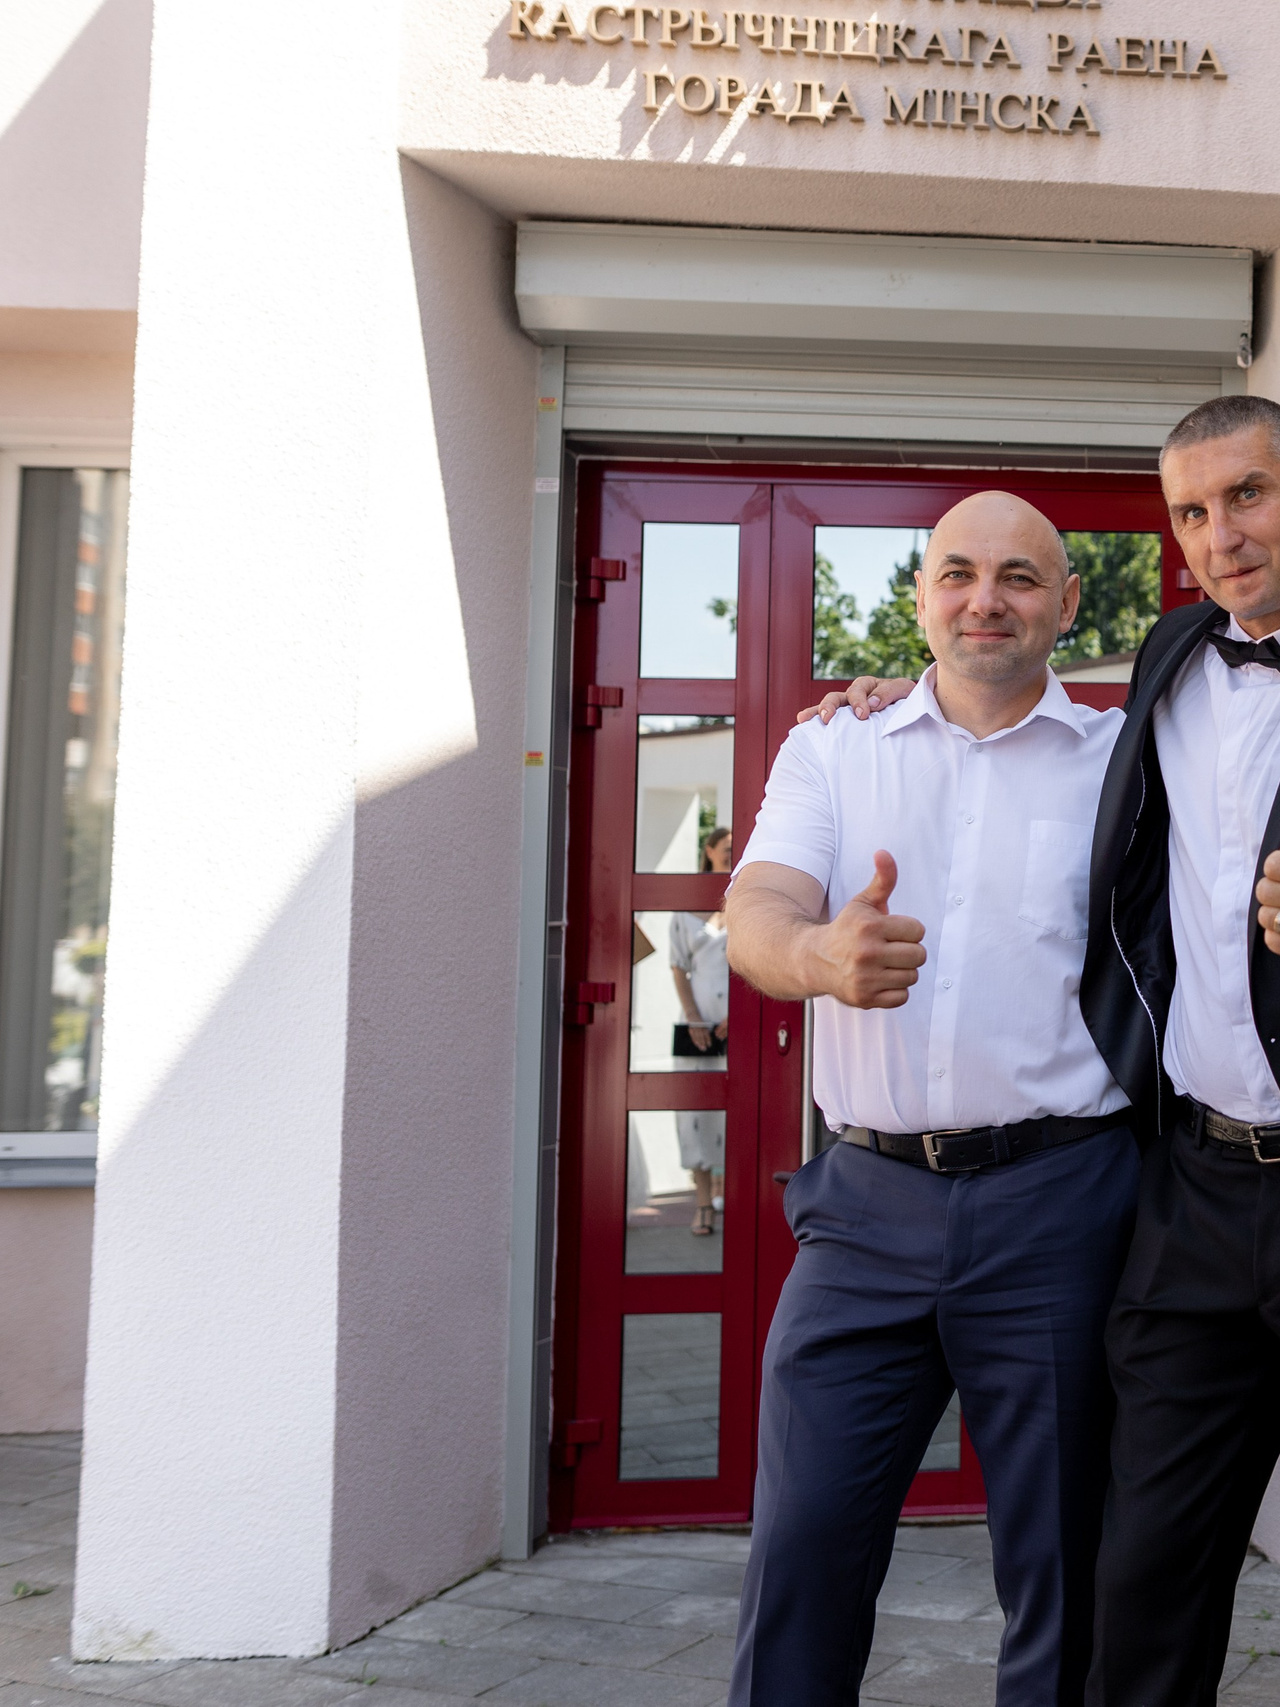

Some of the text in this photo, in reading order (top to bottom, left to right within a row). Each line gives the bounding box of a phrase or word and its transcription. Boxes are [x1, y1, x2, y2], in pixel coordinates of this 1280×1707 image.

[508, 0, 1228, 79] КАСТРЫЧНІЦКАГА РАЕНА
[642, 71, 1100, 136] ГОРАДА МІНСКА
